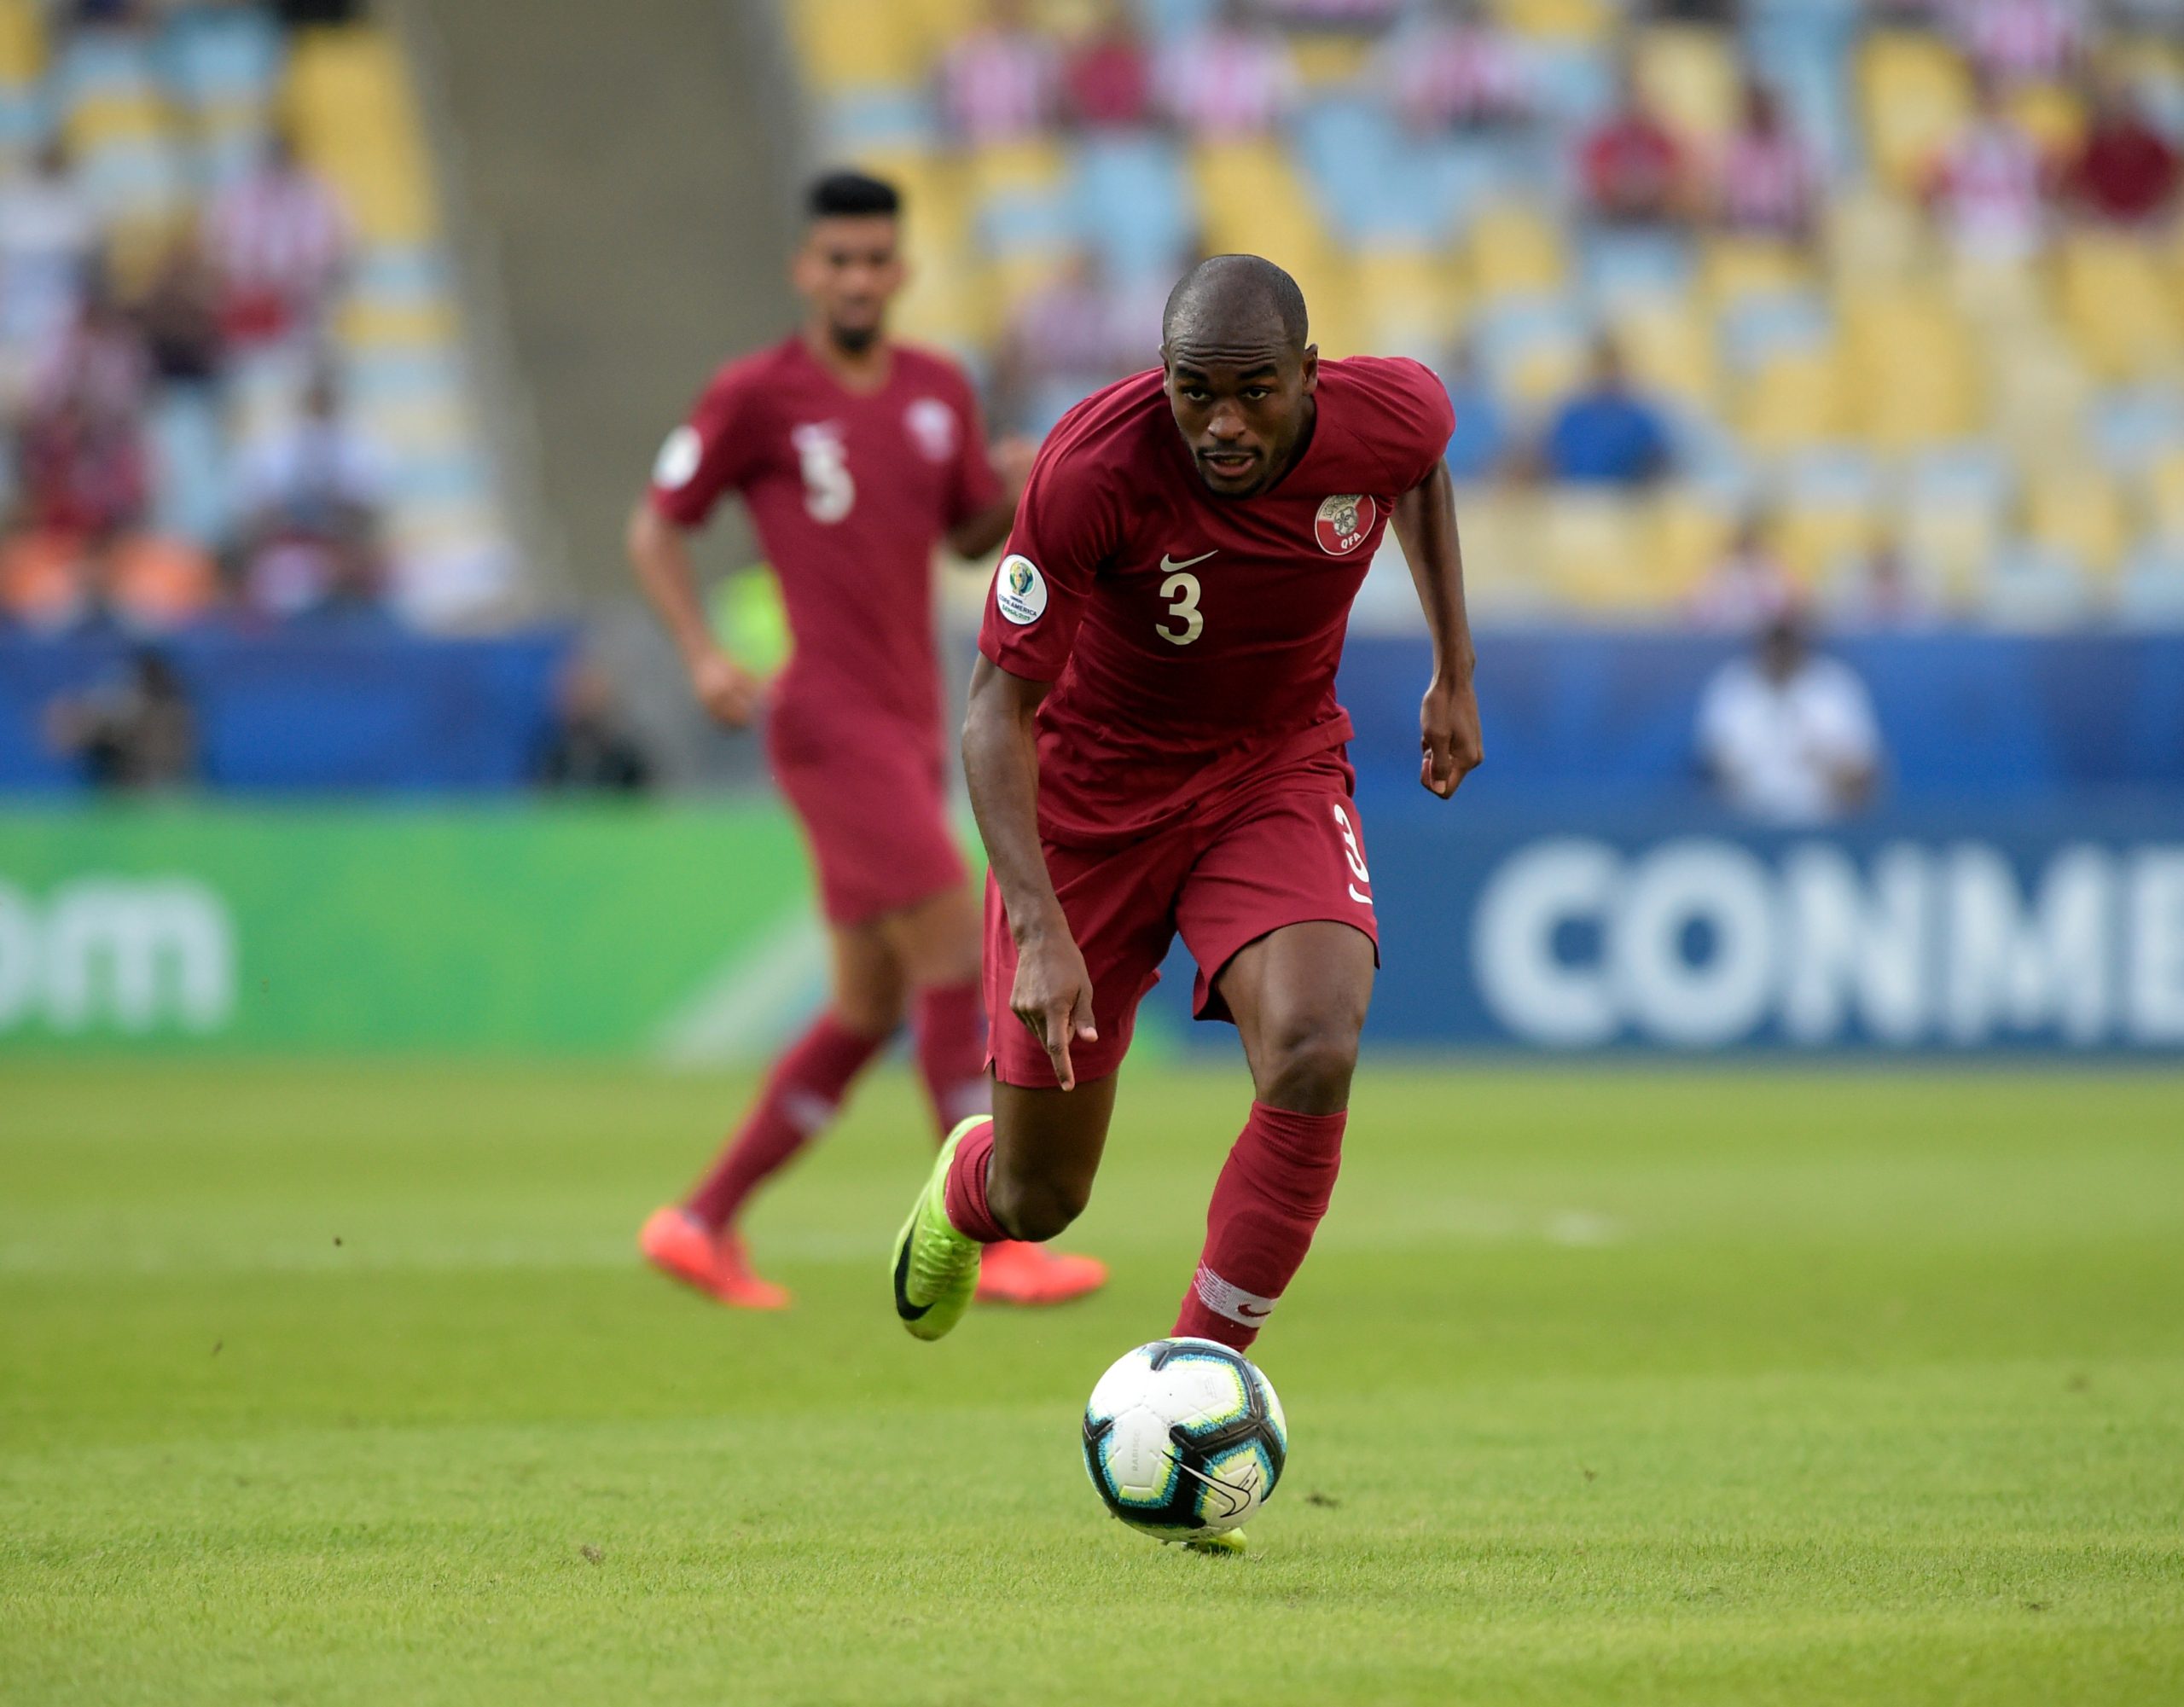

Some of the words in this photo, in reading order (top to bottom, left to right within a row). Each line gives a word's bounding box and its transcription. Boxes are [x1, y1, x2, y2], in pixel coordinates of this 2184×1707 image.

[1340, 531, 1362, 549] QFA
[1155, 572, 1204, 646] 3
[1333, 804, 1370, 883] 3
